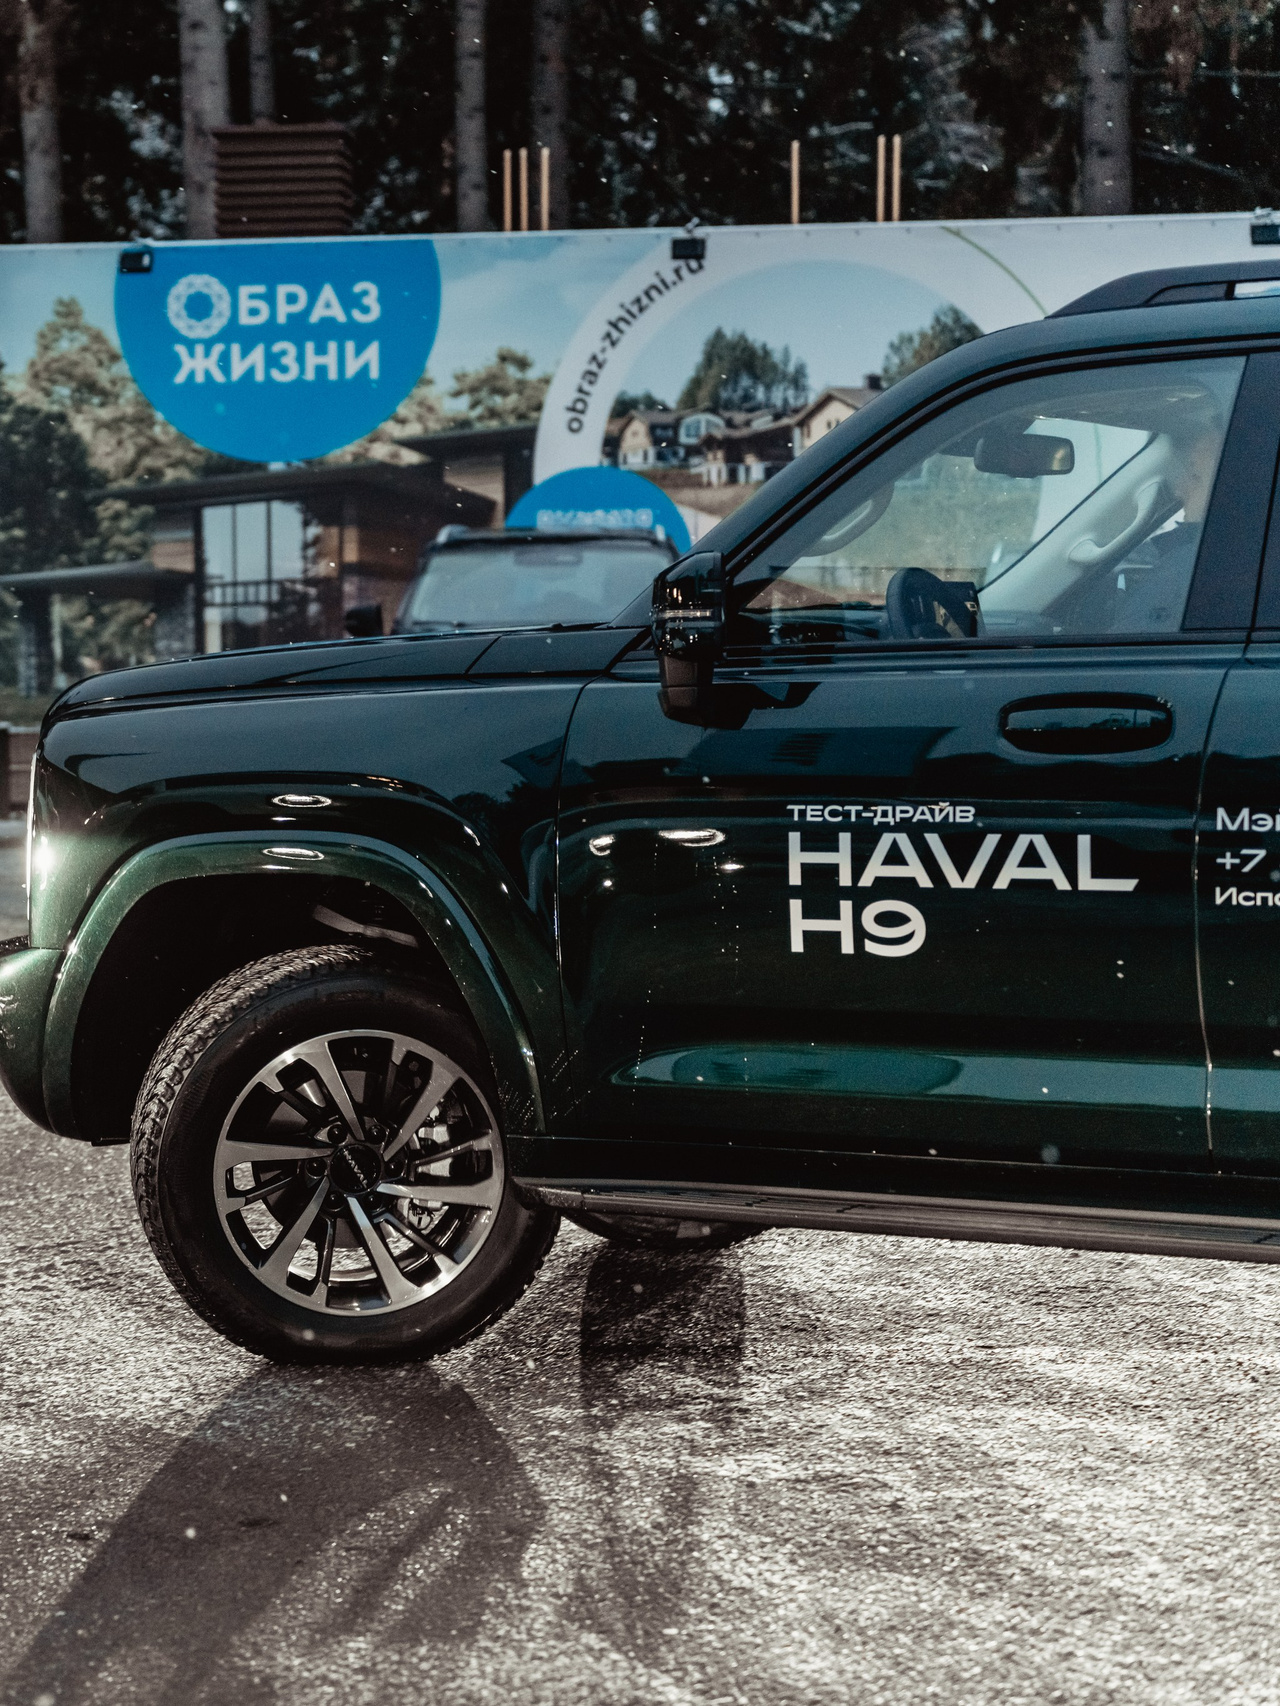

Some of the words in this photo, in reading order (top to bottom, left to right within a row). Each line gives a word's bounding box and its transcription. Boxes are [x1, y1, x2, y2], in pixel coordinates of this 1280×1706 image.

[166, 273, 382, 340] ОБРАЗ
[173, 340, 380, 385] ЖИЗНИ
[566, 258, 705, 434] obraz-zhizni.ru
[786, 801, 976, 826] ТЕСТ-ДРАЙВ
[1216, 807, 1280, 832] Мэ
[788, 831, 1140, 892] HAVAL
[1216, 848, 1268, 873] +7
[789, 898, 927, 957] H9
